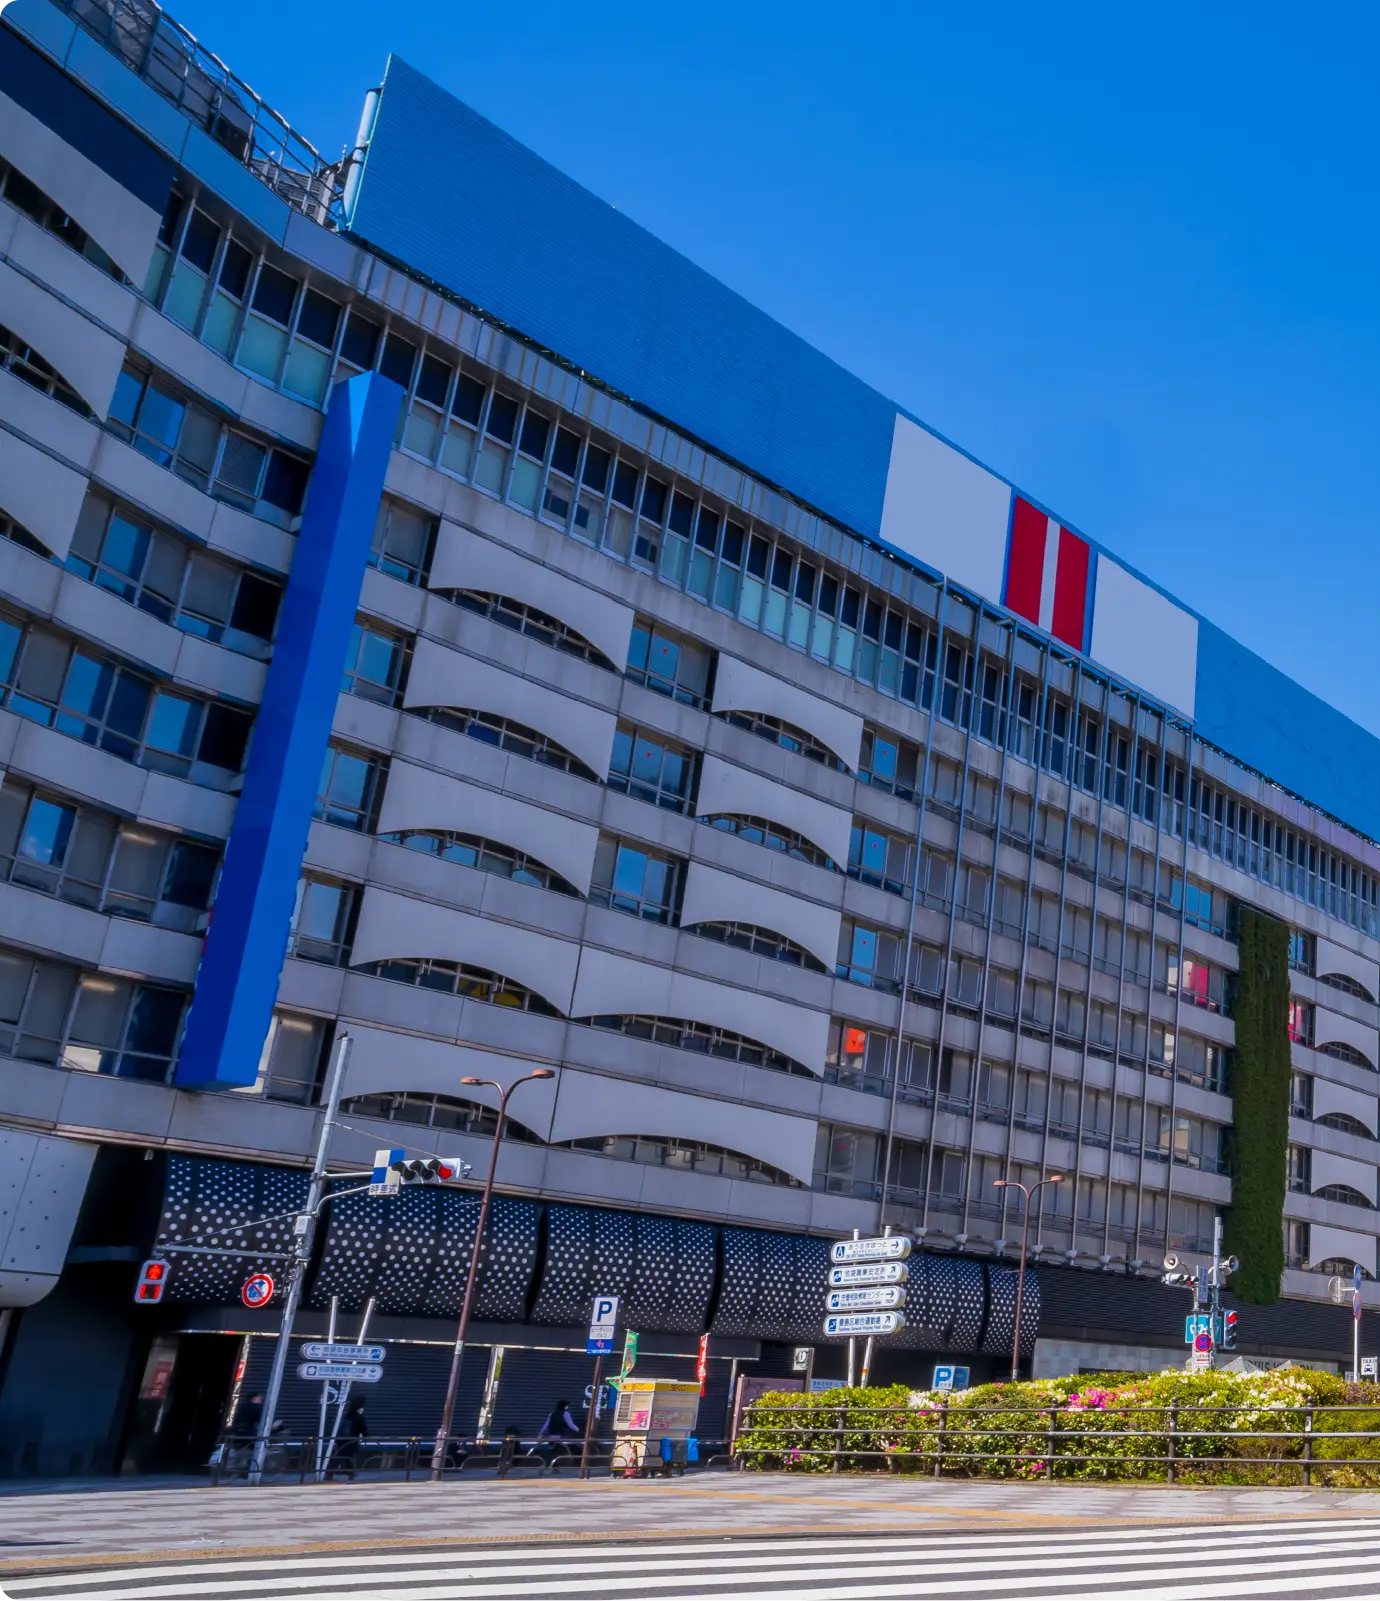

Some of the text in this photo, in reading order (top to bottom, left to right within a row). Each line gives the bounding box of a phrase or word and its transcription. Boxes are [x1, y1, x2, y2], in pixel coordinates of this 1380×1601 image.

[370, 1184, 398, 1194] 時差式
[597, 1301, 613, 1322] P
[936, 1367, 952, 1387] P
